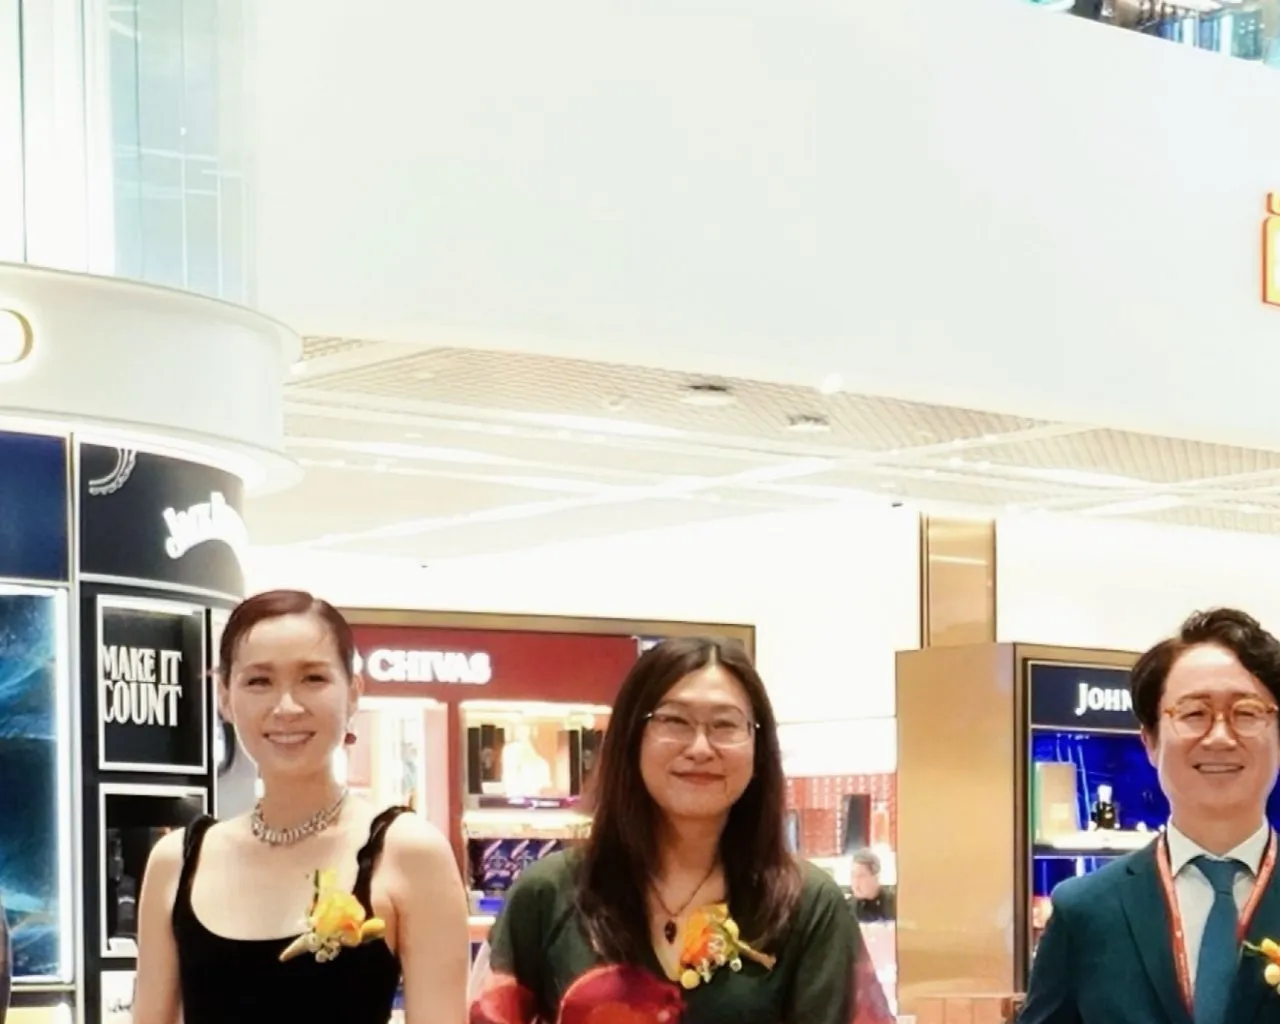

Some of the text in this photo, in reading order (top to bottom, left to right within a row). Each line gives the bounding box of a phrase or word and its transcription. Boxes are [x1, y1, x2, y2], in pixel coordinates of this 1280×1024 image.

[102, 645, 183, 685] MAKE IT
[367, 648, 492, 686] CHIVAS
[102, 680, 183, 726] COUNT
